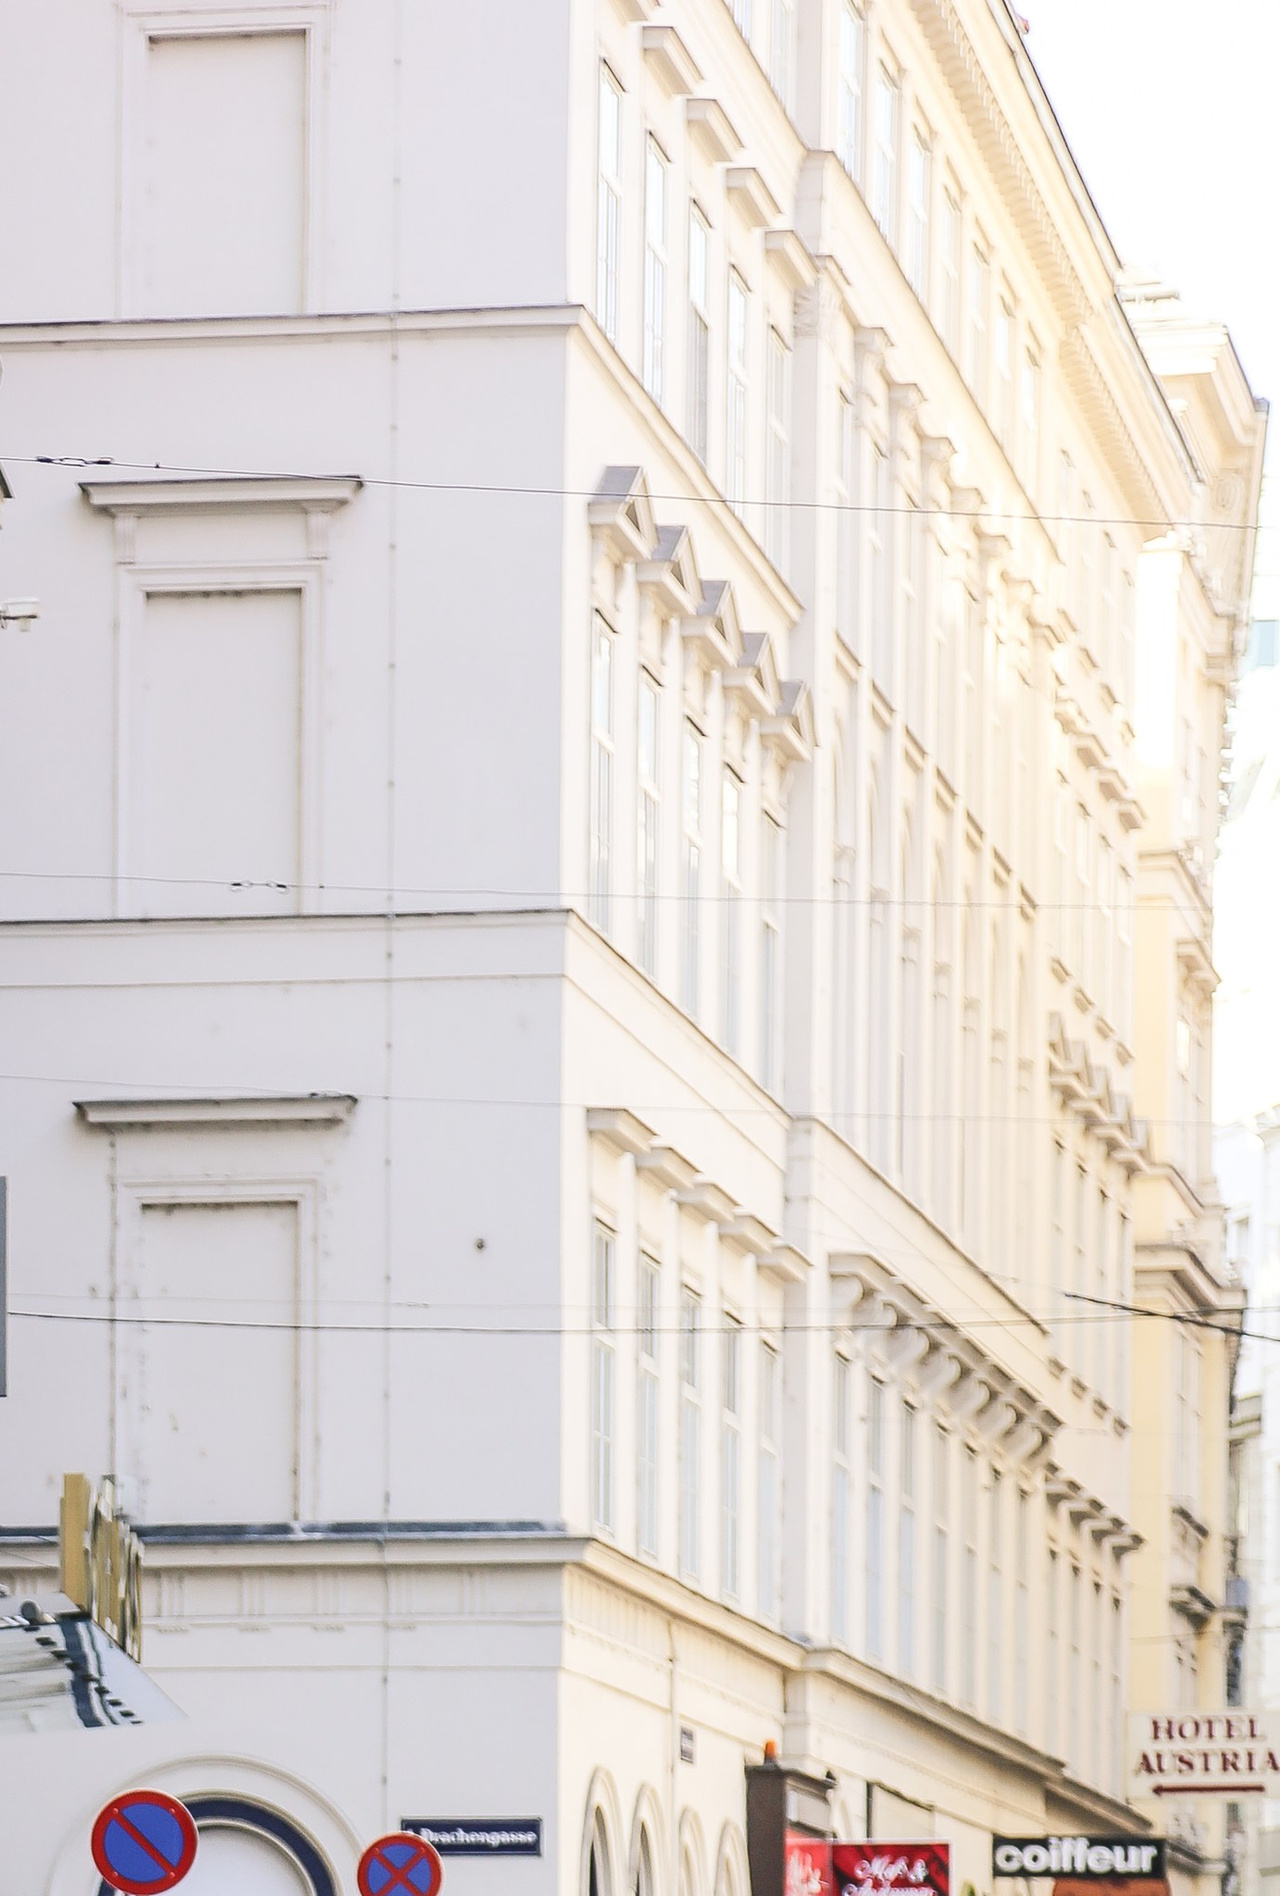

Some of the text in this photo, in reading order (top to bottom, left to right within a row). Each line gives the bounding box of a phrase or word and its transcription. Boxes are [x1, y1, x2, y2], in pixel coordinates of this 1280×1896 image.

[1151, 1717, 1267, 1741] HOTEL
[1136, 1751, 1280, 1775] AUSTRIA
[995, 1836, 1158, 1874] coiffeur
